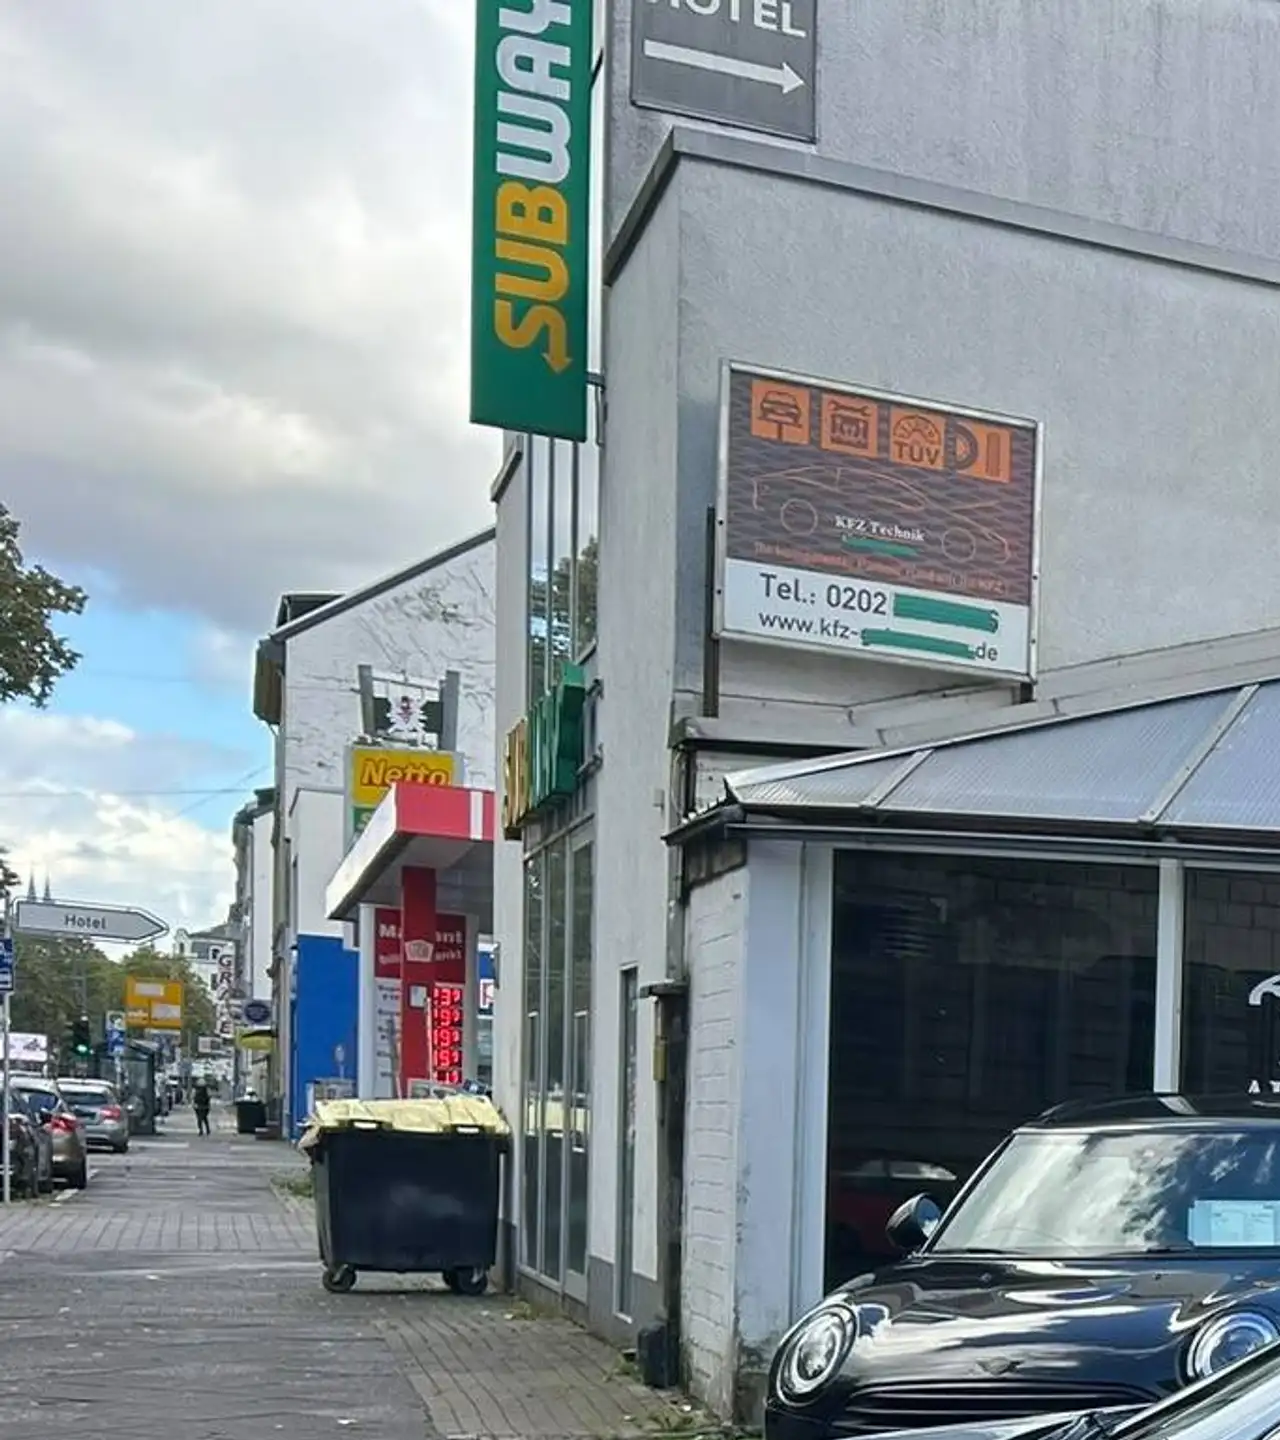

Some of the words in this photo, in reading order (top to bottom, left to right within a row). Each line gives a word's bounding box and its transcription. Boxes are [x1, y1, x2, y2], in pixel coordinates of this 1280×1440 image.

[494, 0, 574, 375] SUBWAY
[870, 521, 925, 541] Technik
[759, 573, 816, 606] Tel.:
[826, 584, 888, 616] 0202
[361, 758, 448, 787] Netto
[64, 914, 106, 930] Hotel
